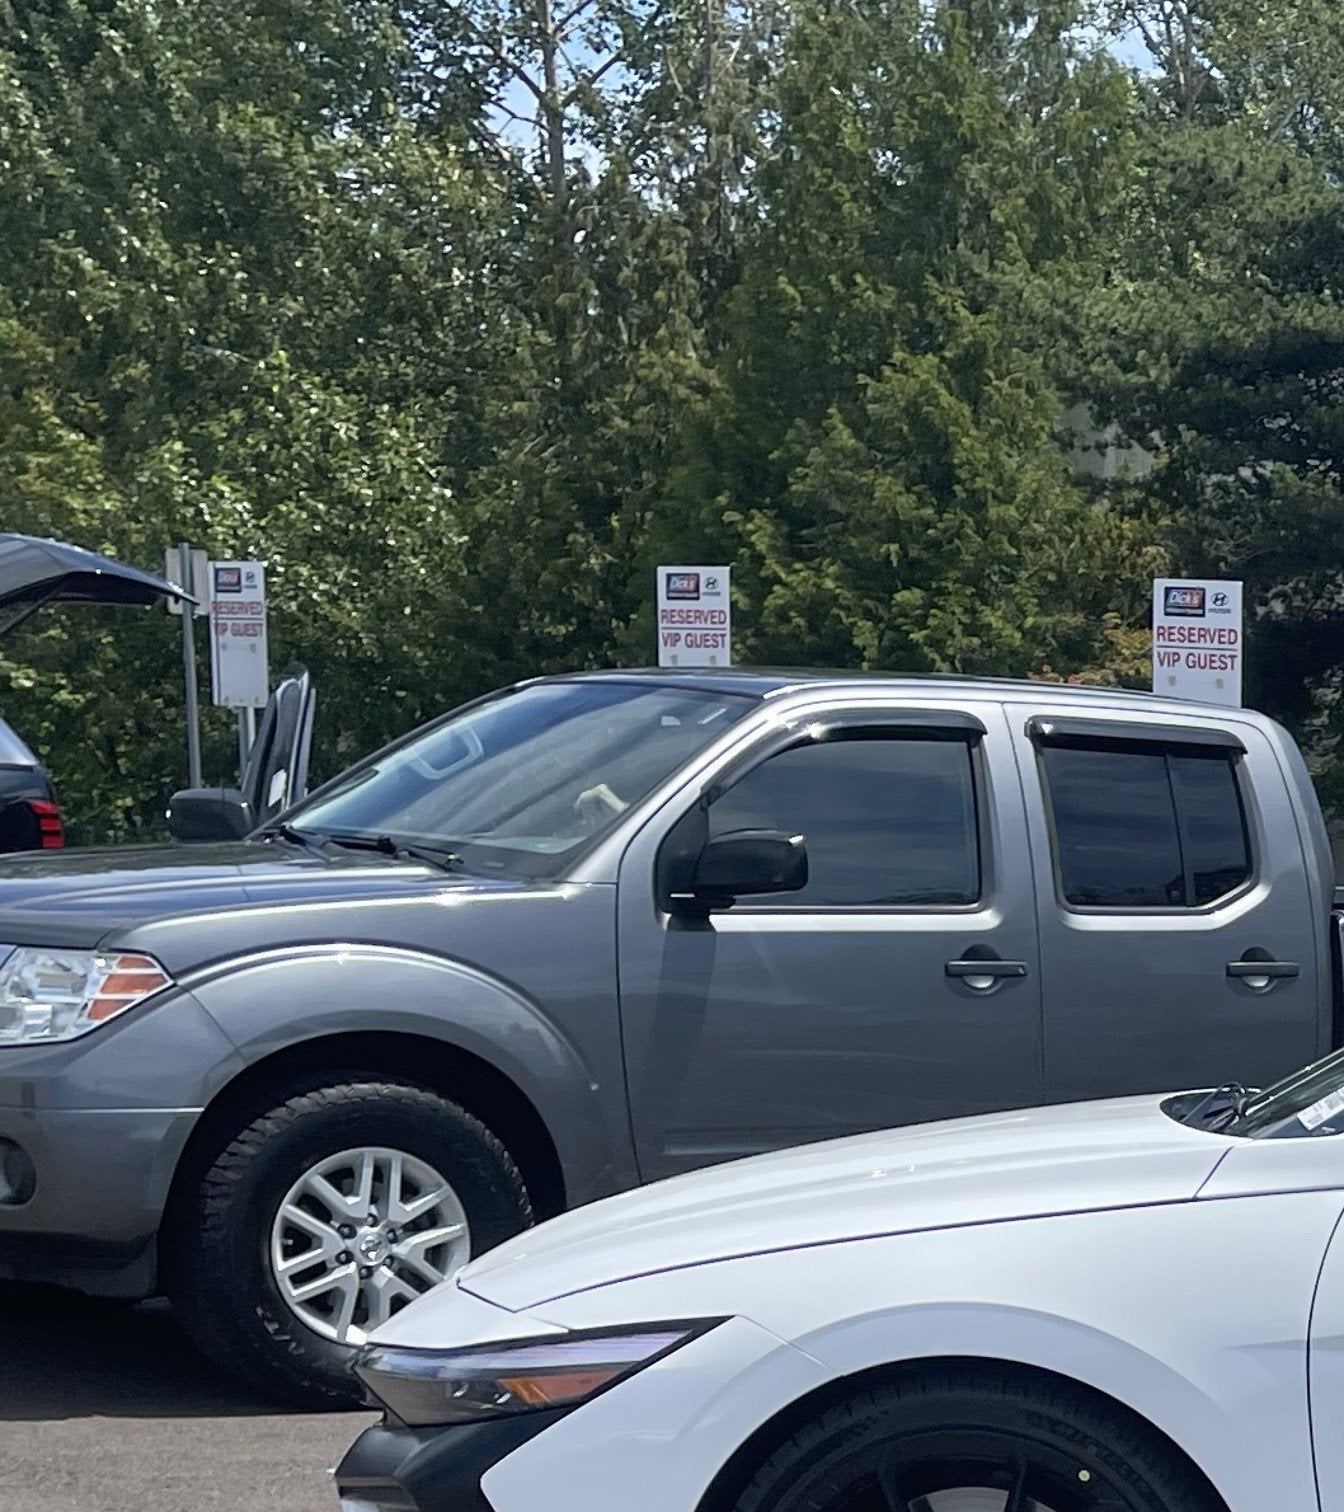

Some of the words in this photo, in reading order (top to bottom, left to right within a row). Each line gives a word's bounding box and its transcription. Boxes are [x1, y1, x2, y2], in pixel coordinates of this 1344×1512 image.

[661, 609, 727, 625] RESERVED
[661, 632, 681, 648] VIP
[684, 632, 727, 648] GUEST
[1156, 625, 1238, 645] RESERVED
[1156, 651, 1181, 668] VIP
[1184, 652, 1238, 671] GUEST
